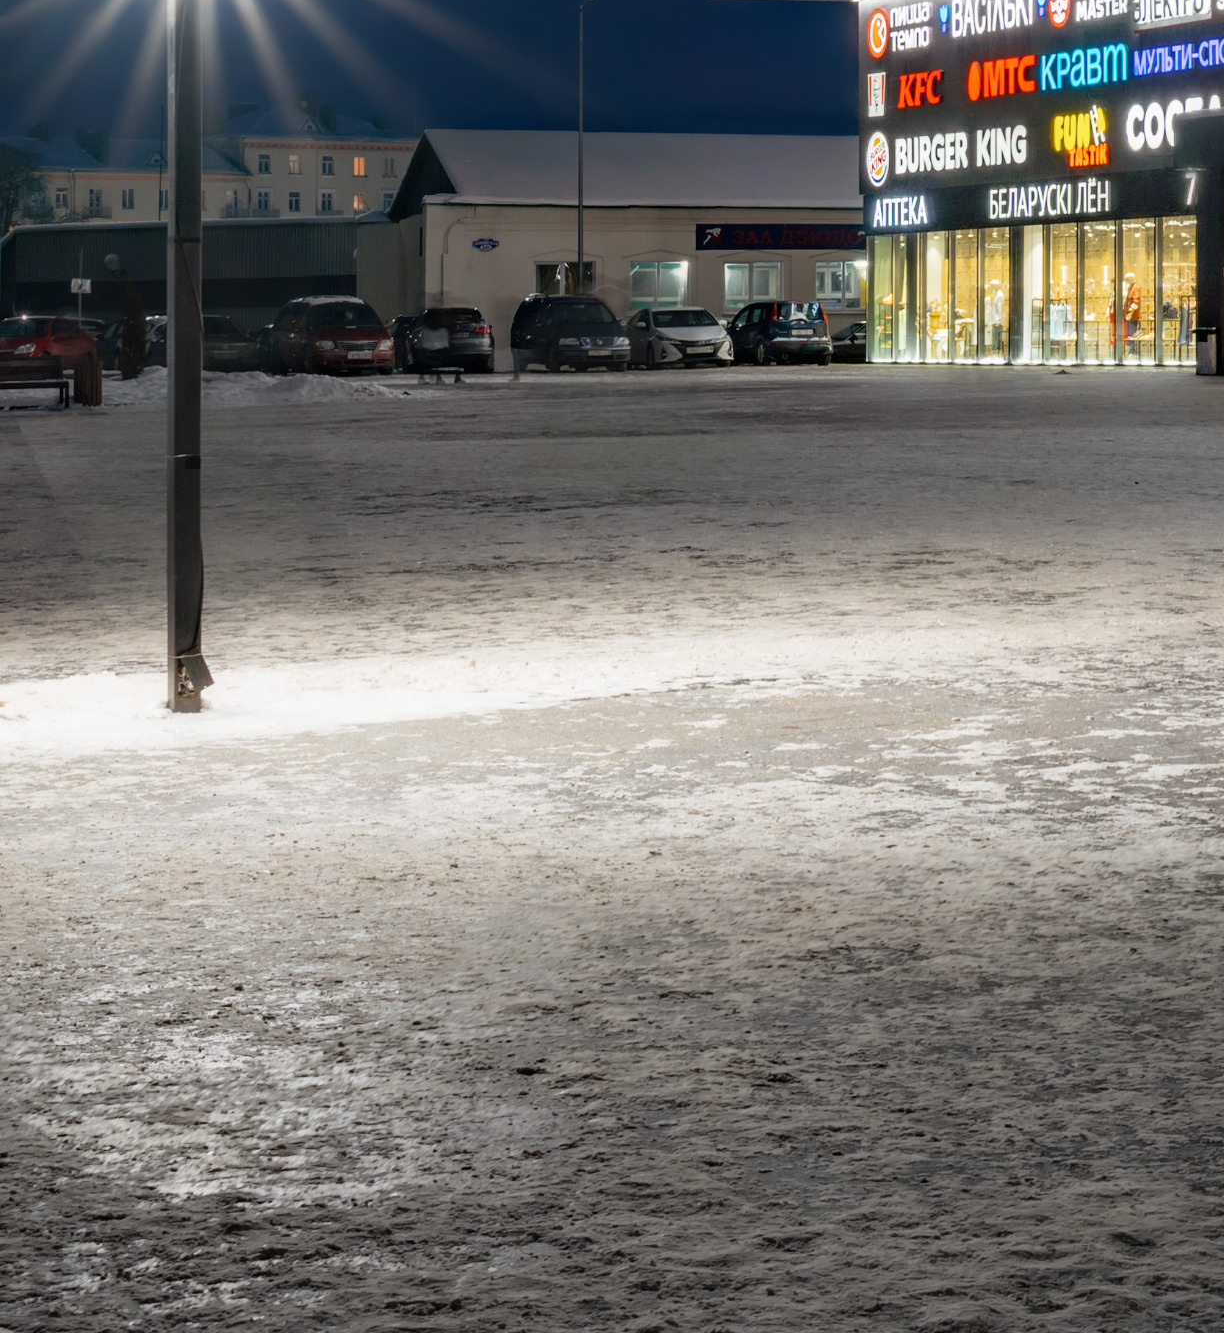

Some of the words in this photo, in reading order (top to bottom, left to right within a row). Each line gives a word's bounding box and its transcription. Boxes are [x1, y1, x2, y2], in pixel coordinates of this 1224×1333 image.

[897, 69, 943, 109] KFC
[983, 54, 1036, 98] МТС
[895, 131, 969, 175] BURGER
[976, 124, 1027, 167] KING
[1068, 142, 1108, 168] TASTIK
[873, 195, 928, 228] АПТЕКА
[1075, 177, 1109, 214] ЛЁН
[733, 229, 774, 245] ЗАЛ
